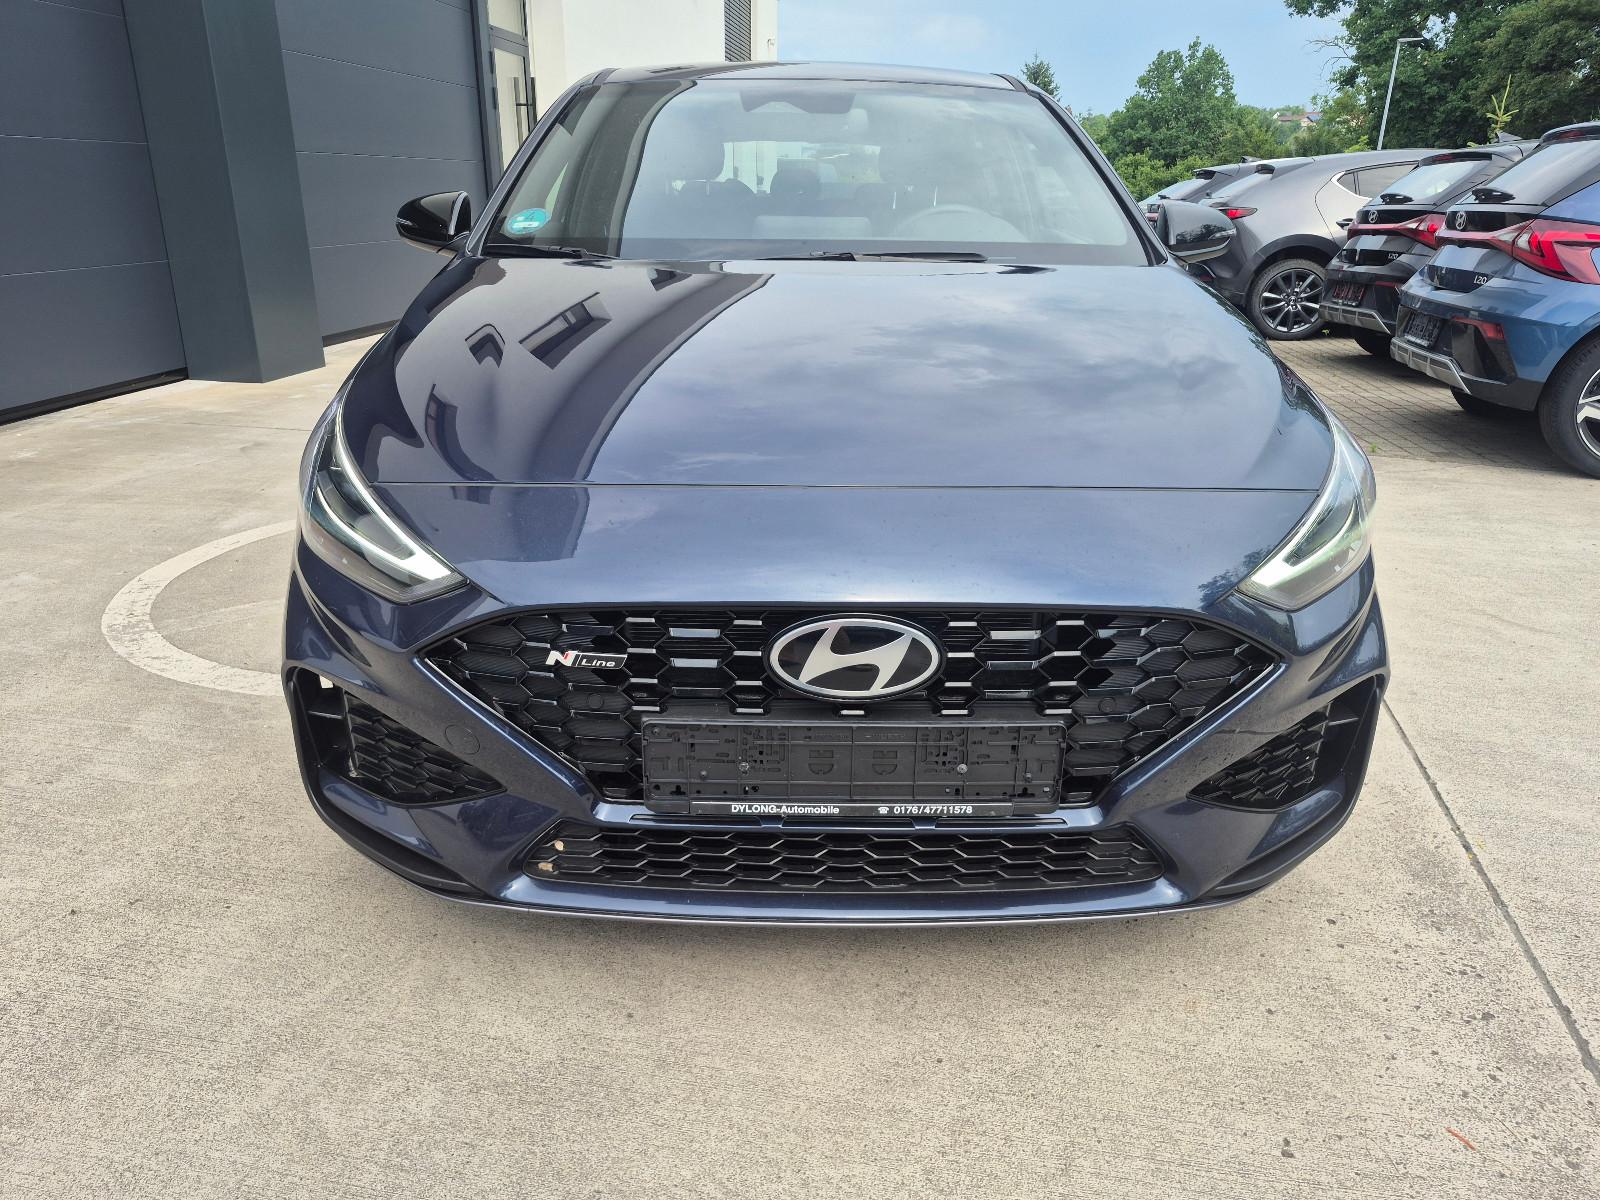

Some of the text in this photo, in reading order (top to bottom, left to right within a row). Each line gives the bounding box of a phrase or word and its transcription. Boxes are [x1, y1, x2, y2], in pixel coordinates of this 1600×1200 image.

[545, 650, 616, 667] N Line
[731, 804, 973, 814] DYLONG-Automobile 0176/47711578
